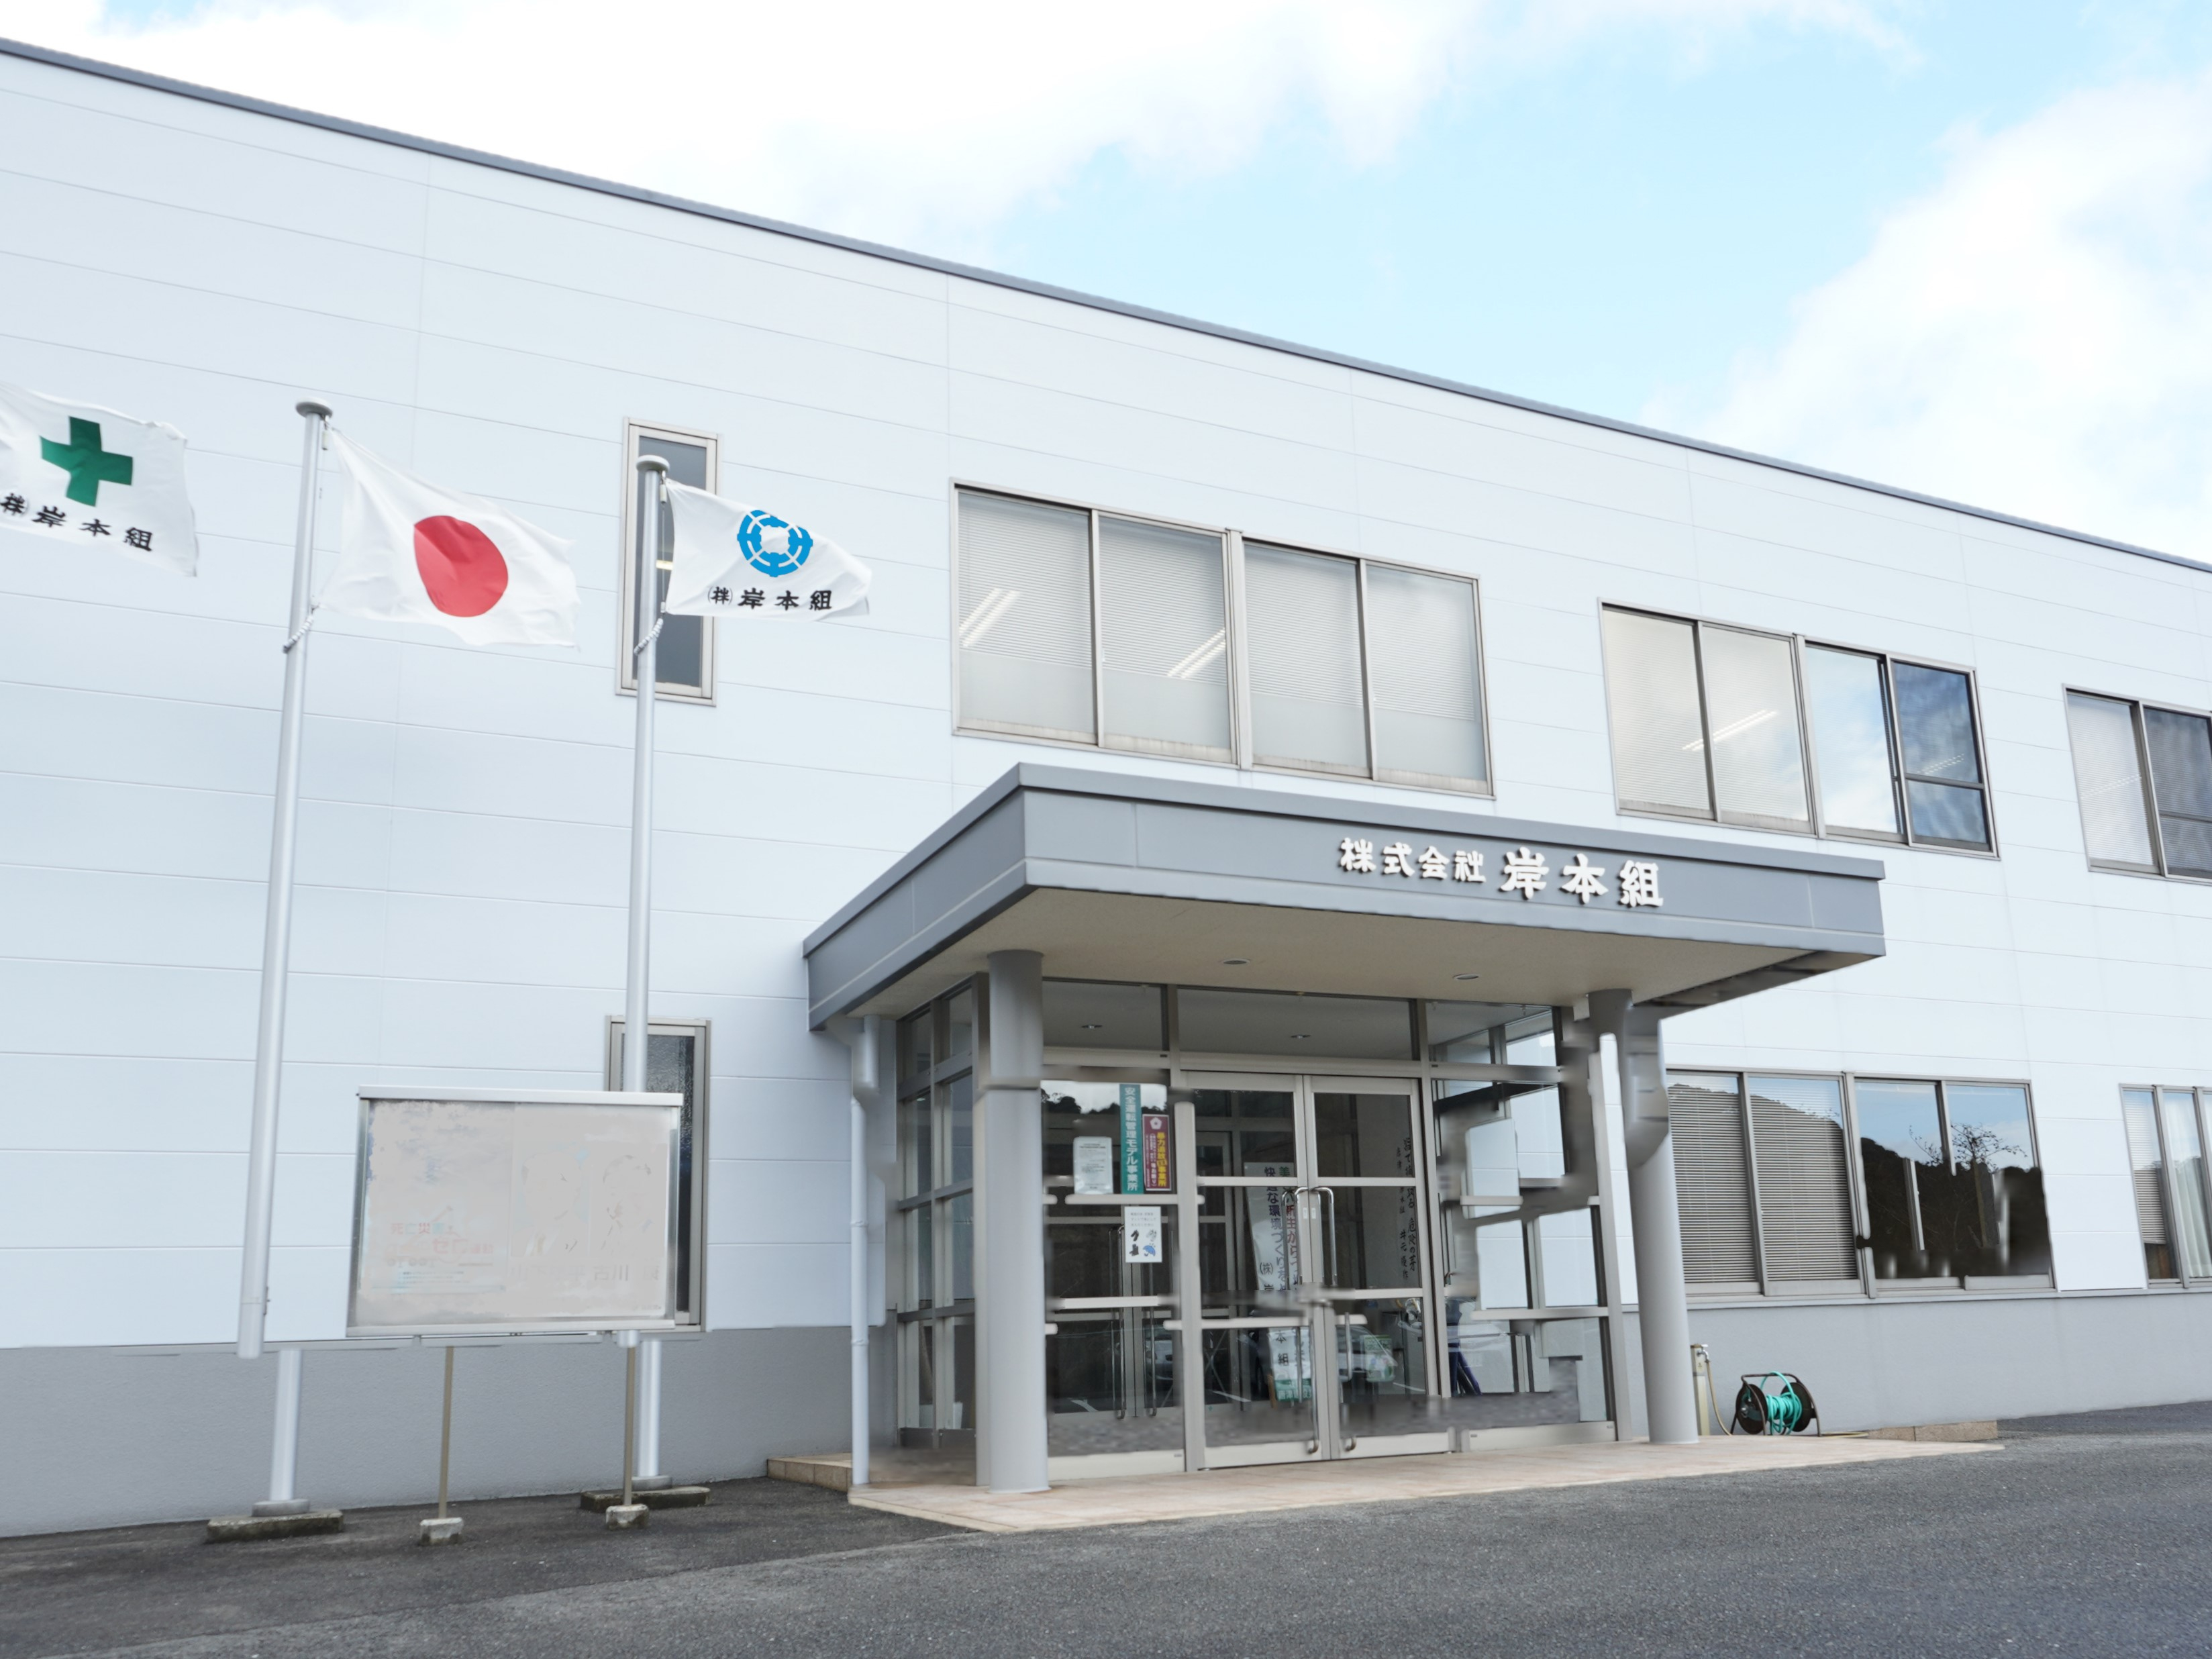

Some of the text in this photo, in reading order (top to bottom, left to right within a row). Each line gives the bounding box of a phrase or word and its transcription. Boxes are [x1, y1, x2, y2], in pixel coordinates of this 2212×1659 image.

[0, 493, 153, 552] 株)岸本組
[707, 586, 833, 611] (株)岸本組
[1125, 1087, 1138, 1191] 安全運転管理モデル事業所
